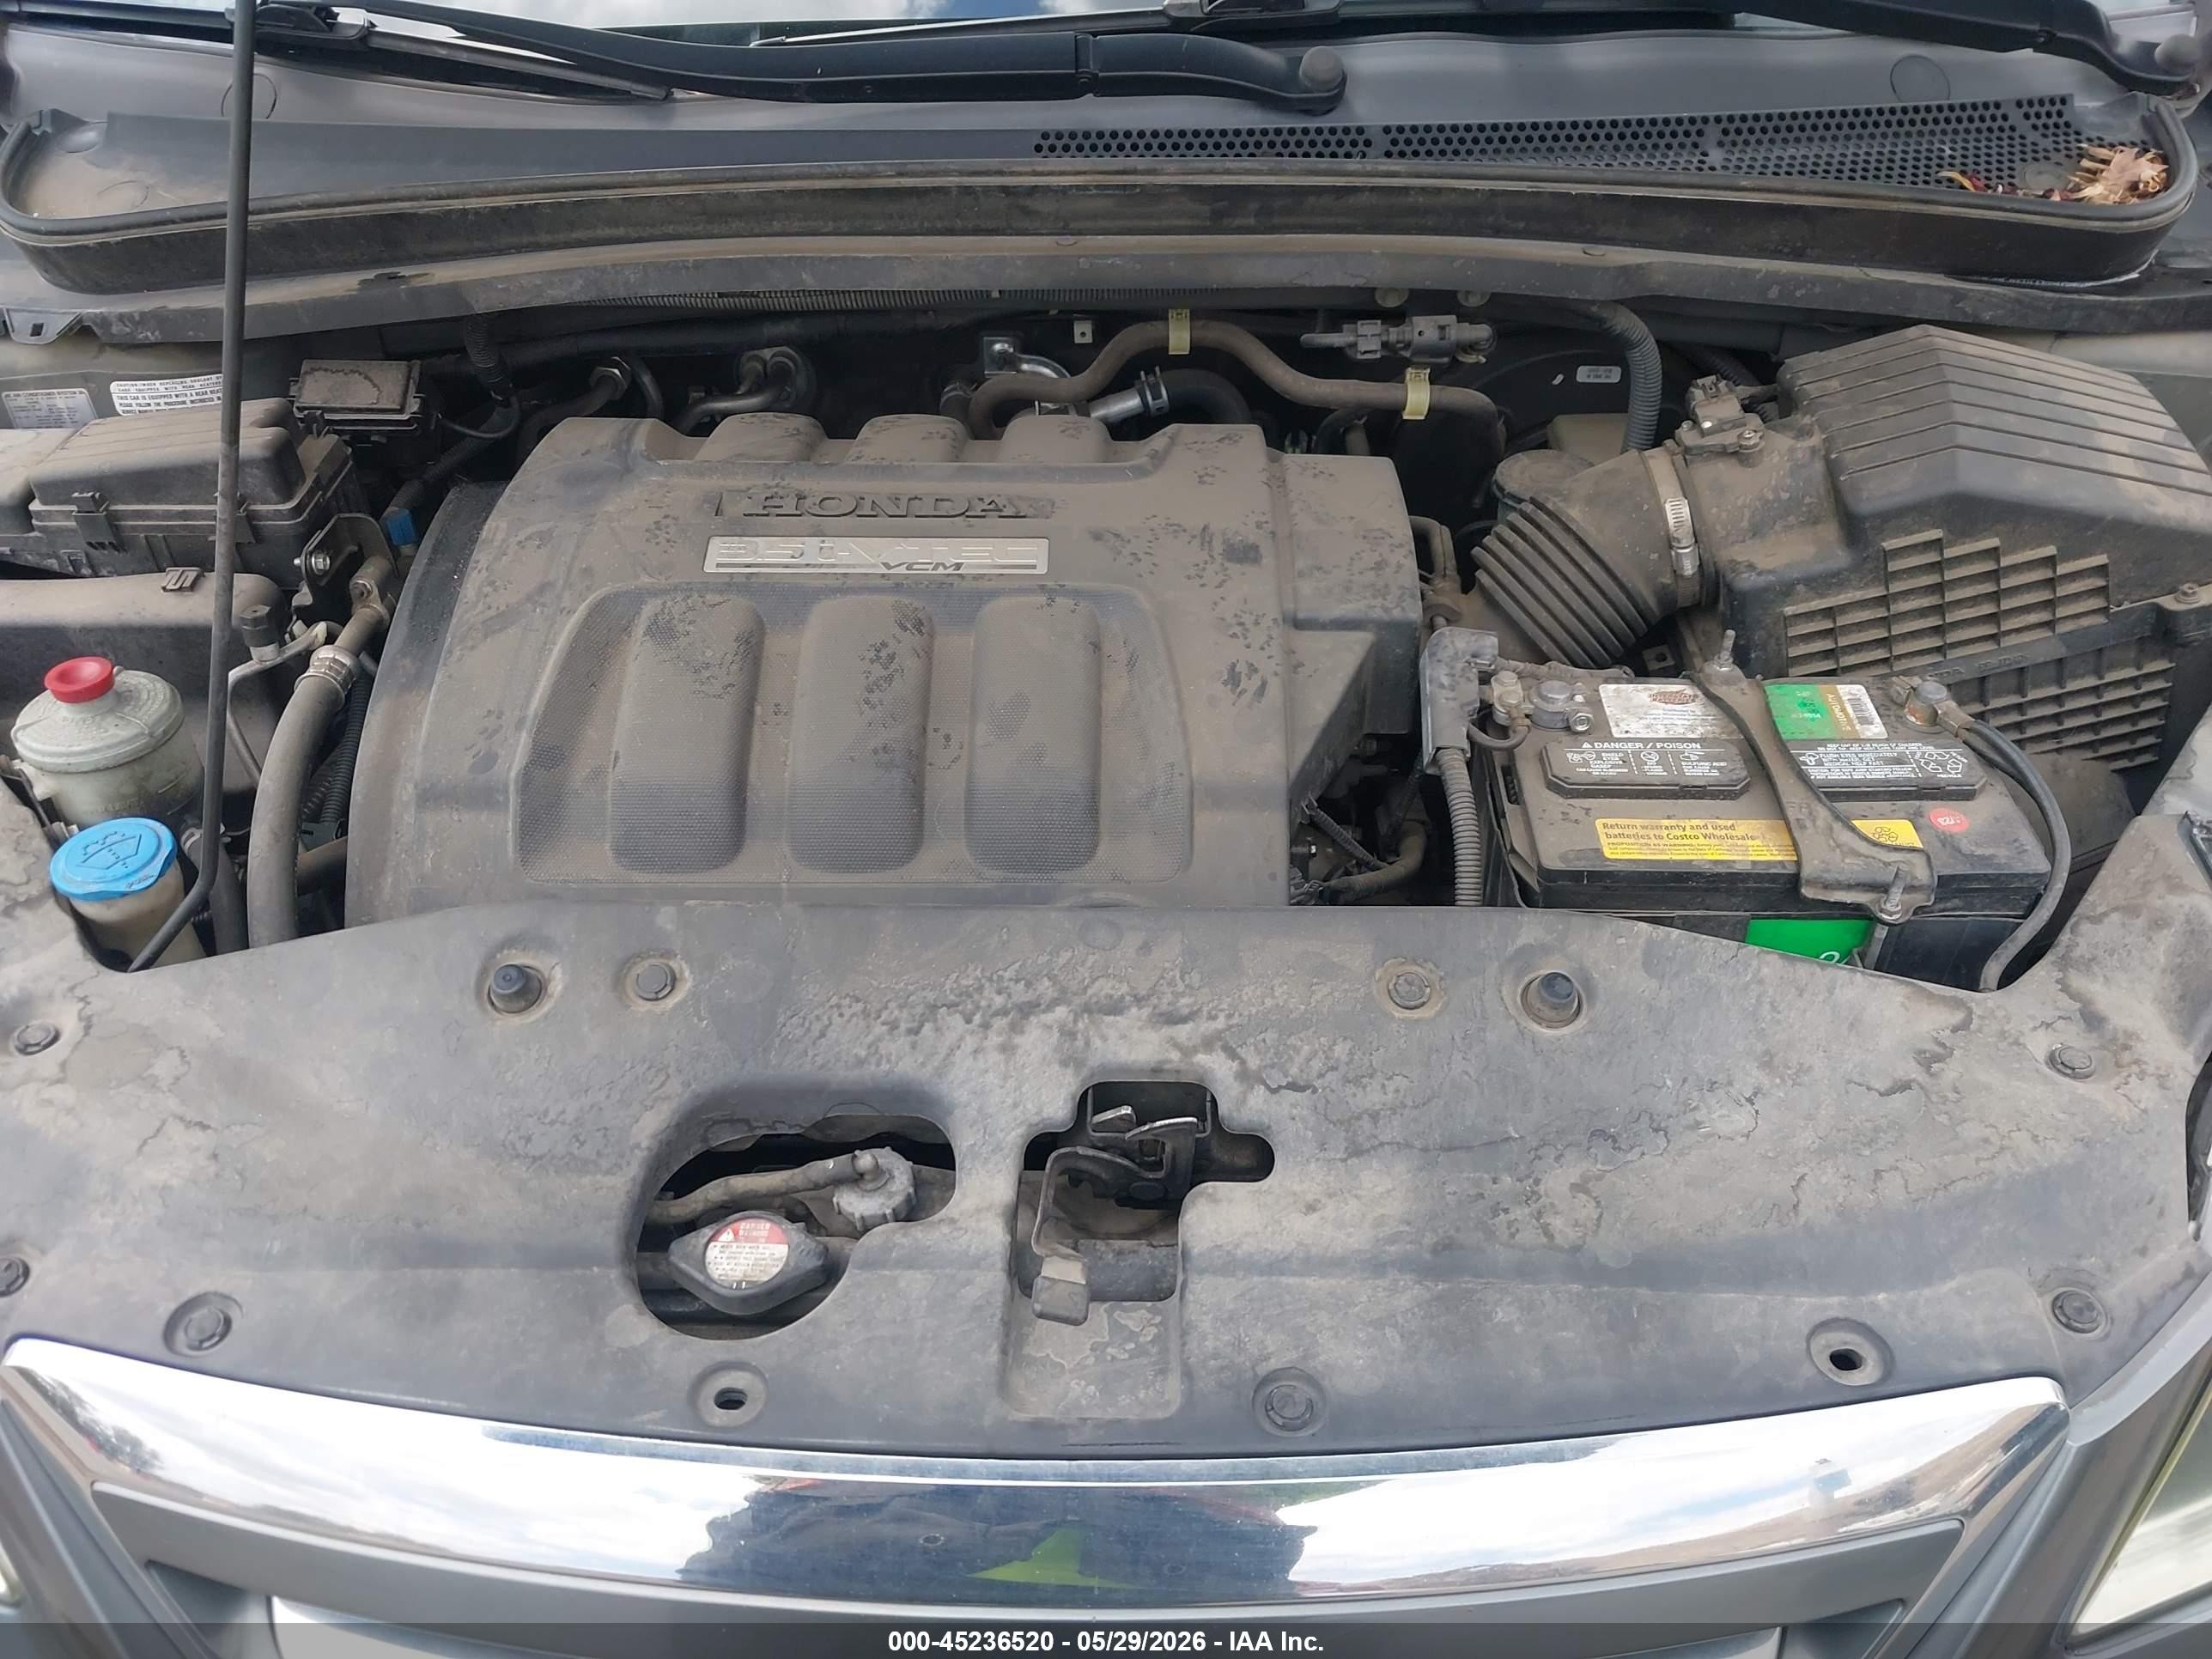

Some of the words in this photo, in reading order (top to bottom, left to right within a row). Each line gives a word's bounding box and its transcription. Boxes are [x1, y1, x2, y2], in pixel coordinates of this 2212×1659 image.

[742, 494, 1028, 518] HONDA
[879, 562, 966, 572] VCM
[1639, 823, 1686, 832] warranty
[1711, 823, 1736, 831] used
[1666, 832, 1700, 841] Costco
[1702, 832, 1756, 841] Wholesale
